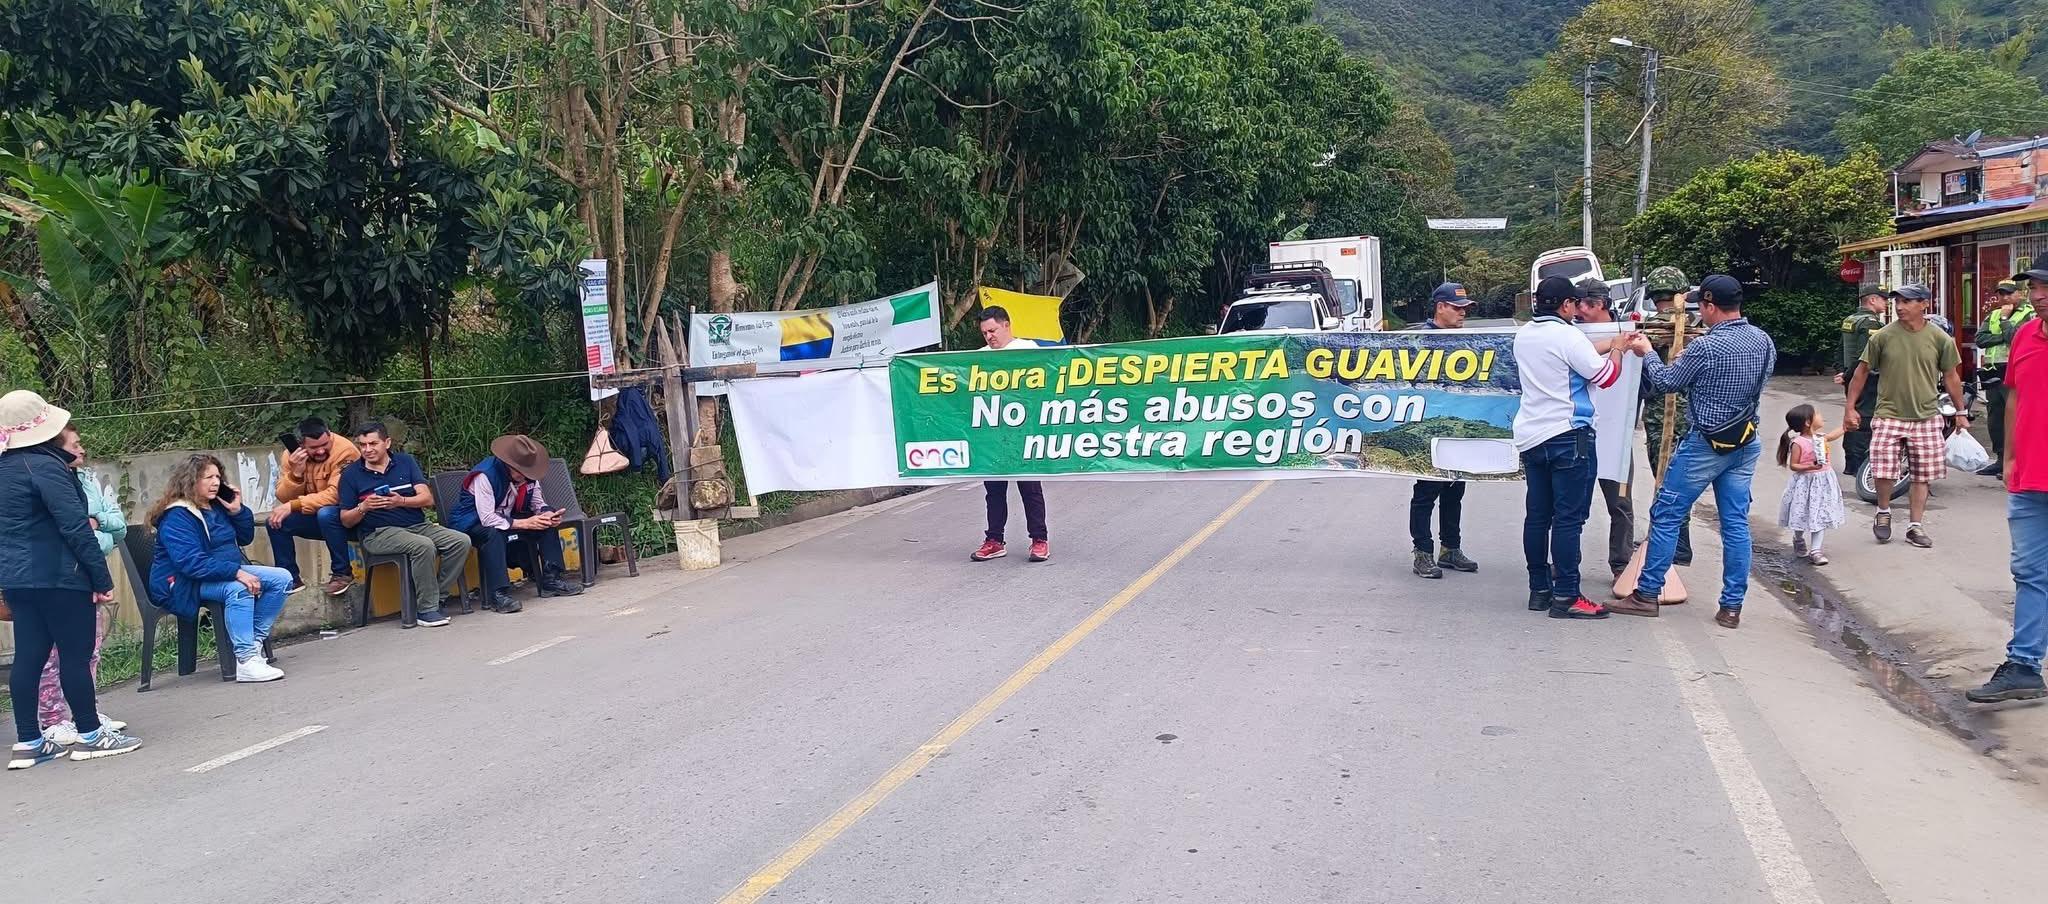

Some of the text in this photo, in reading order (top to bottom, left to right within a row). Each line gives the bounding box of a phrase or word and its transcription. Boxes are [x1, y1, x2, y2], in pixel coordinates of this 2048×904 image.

[918, 347, 1496, 394] Es hora ¡DESPIERTA GUAVIO!
[971, 386, 1427, 428] No más abusos con
[908, 441, 966, 467] enel
[1022, 417, 1363, 465] nuestra región
